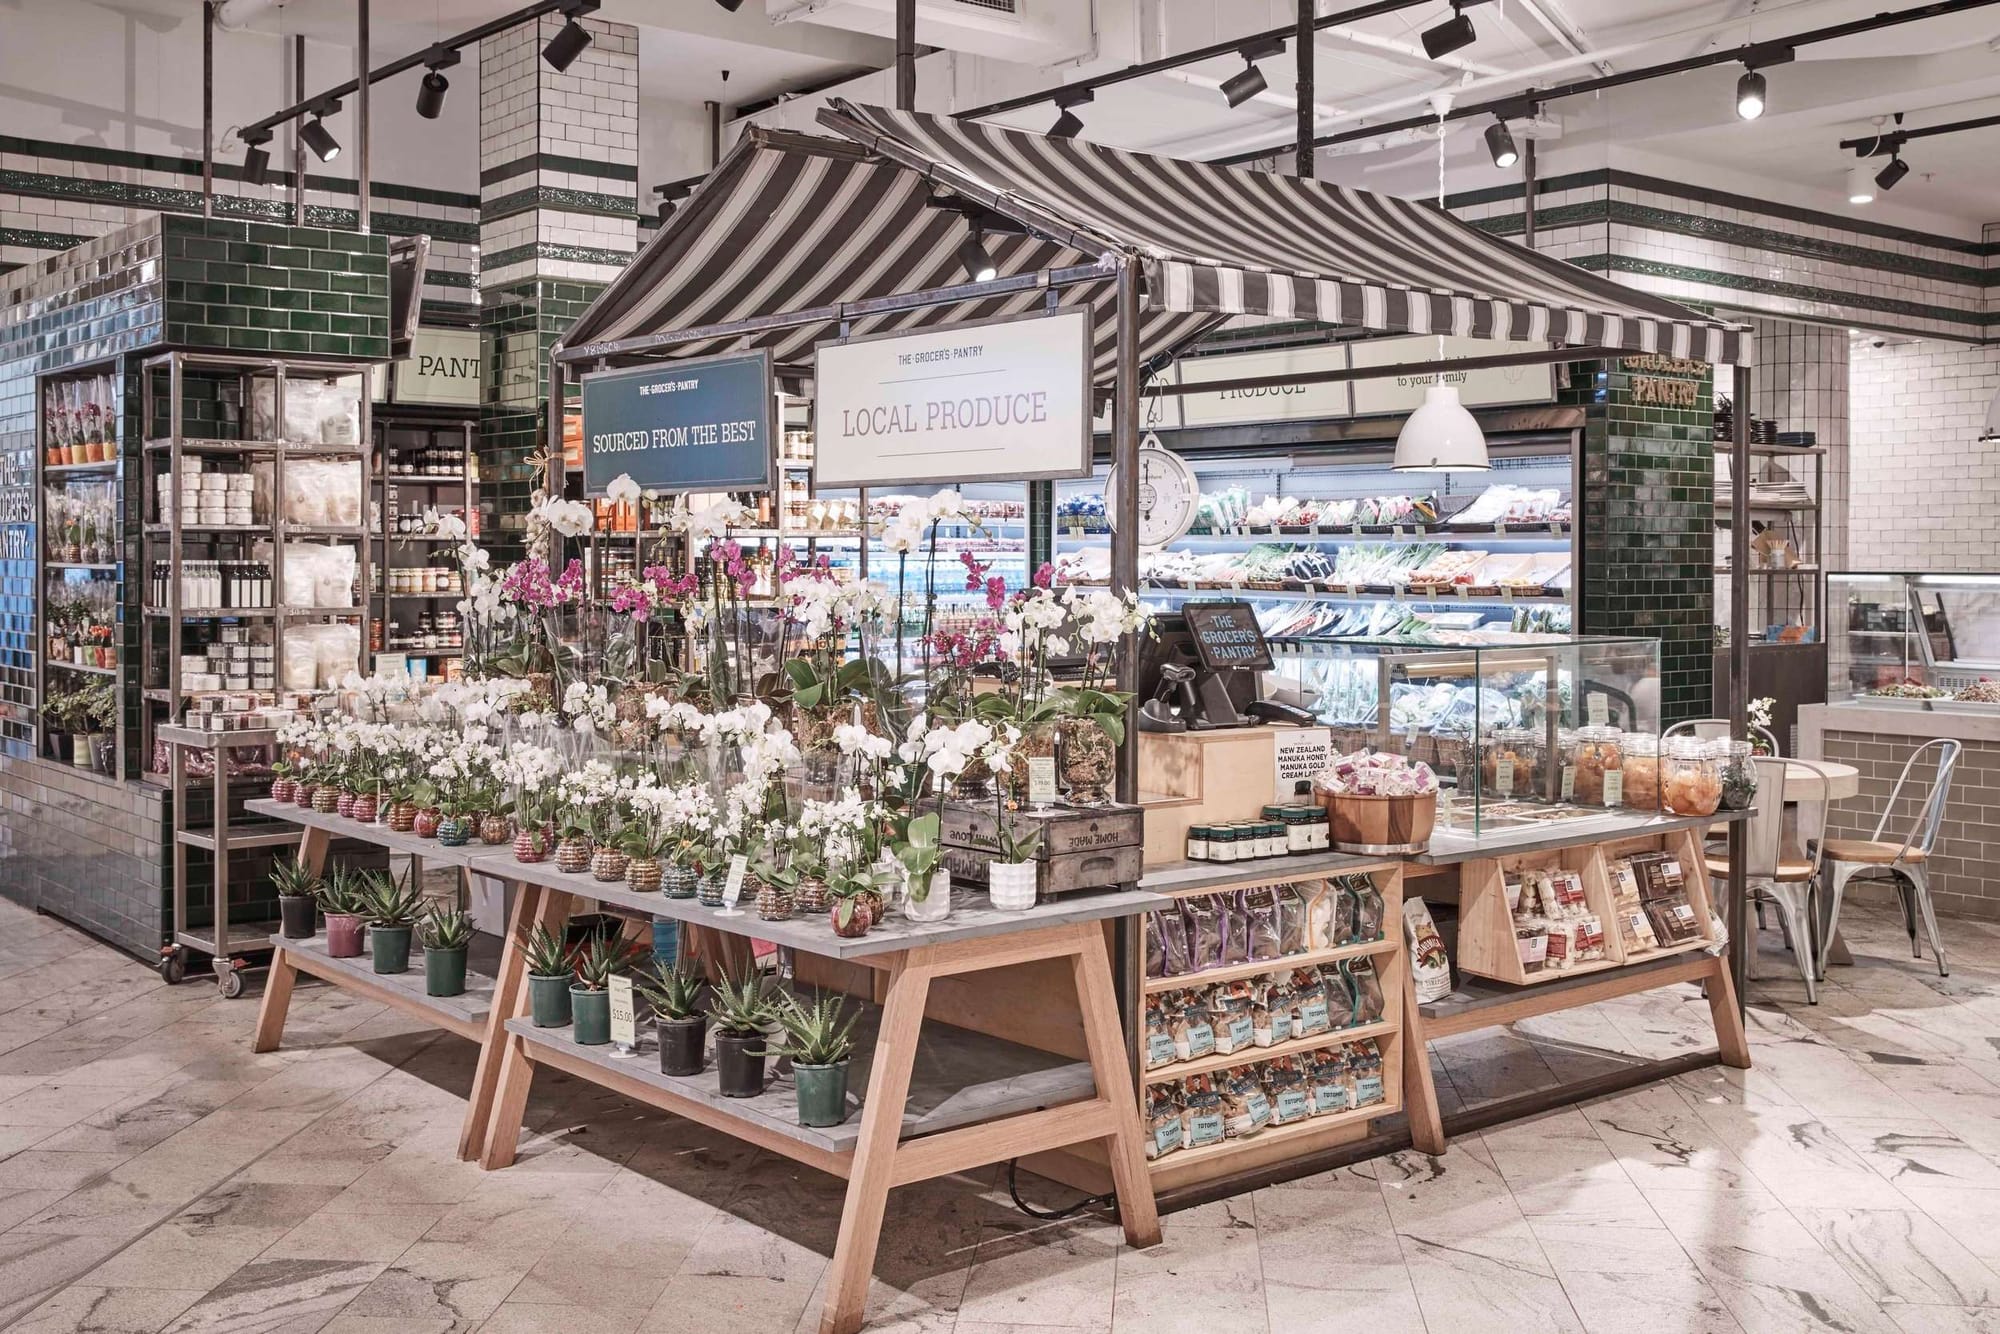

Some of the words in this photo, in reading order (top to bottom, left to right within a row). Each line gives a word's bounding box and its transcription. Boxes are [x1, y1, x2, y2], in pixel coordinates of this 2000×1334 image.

[898, 354, 912, 366] THE
[915, 348, 950, 364] GROCER'S
[953, 345, 984, 359] PANTRY
[639, 385, 650, 397] THE
[651, 381, 676, 395] GROCER'S
[677, 379, 699, 392] PANTRY
[1397, 377, 1407, 387] to
[1410, 375, 1433, 388] your
[842, 404, 918, 438] LOCAL
[926, 391, 1048, 431] PRODUCE
[593, 430, 649, 454] SOURCED
[652, 426, 689, 449] FROM
[691, 423, 718, 446] THE
[722, 420, 757, 443] BEST
[1210, 615, 1235, 628] THE
[1201, 628, 1256, 644] GROCER'S
[1212, 645, 1257, 660] PANTRY
[1296, 745, 1326, 754] ZEALAND
[1278, 755, 1305, 763] MANUKA
[1306, 753, 1328, 761] HONEY
[1280, 763, 1307, 771] MANUKA
[1069, 835, 1093, 848] MADE
[1095, 831, 1119, 845] HOME
[612, 1008, 633, 1024] $15.00
